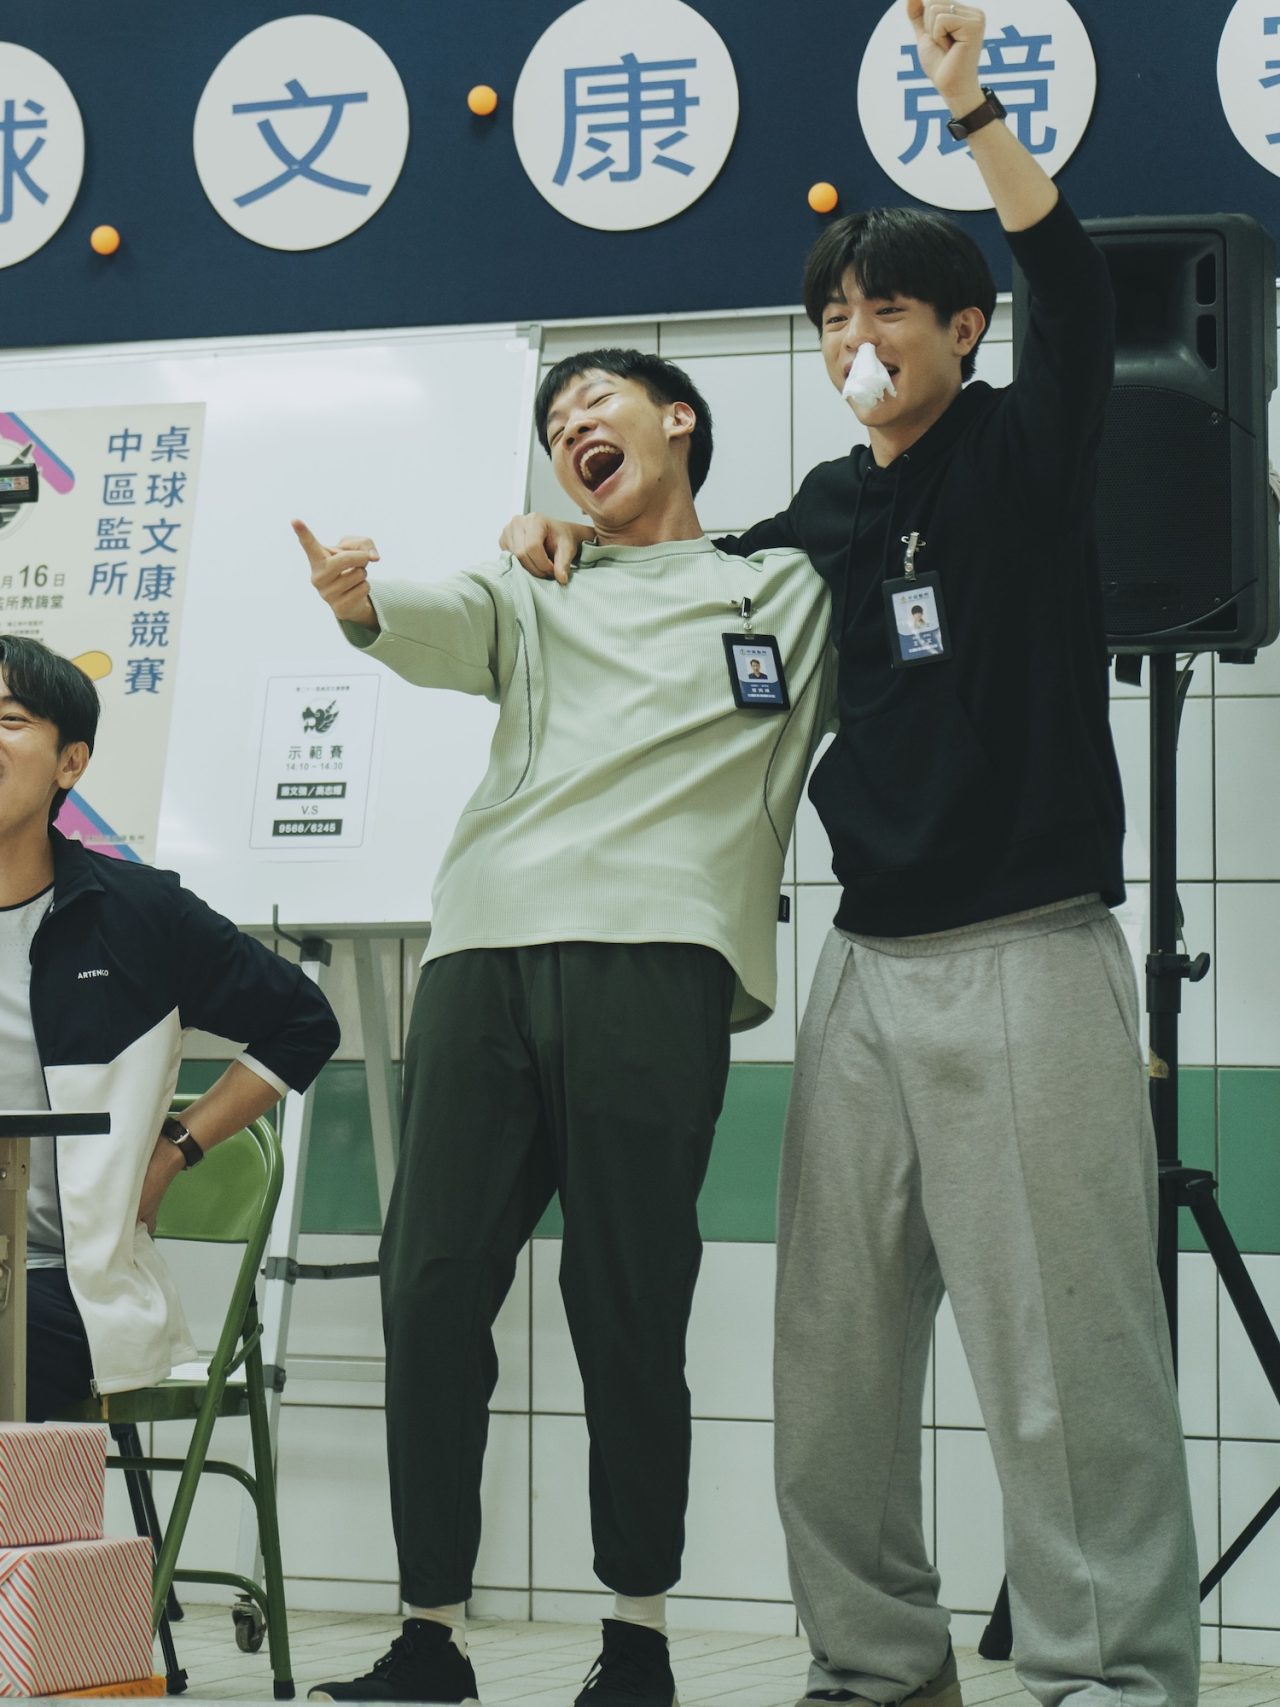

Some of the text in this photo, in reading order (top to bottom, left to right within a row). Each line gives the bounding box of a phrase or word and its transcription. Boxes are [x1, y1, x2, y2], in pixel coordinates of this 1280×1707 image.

[88, 427, 143, 597] 中區監所
[123, 425, 192, 697] 桌球文康競賽
